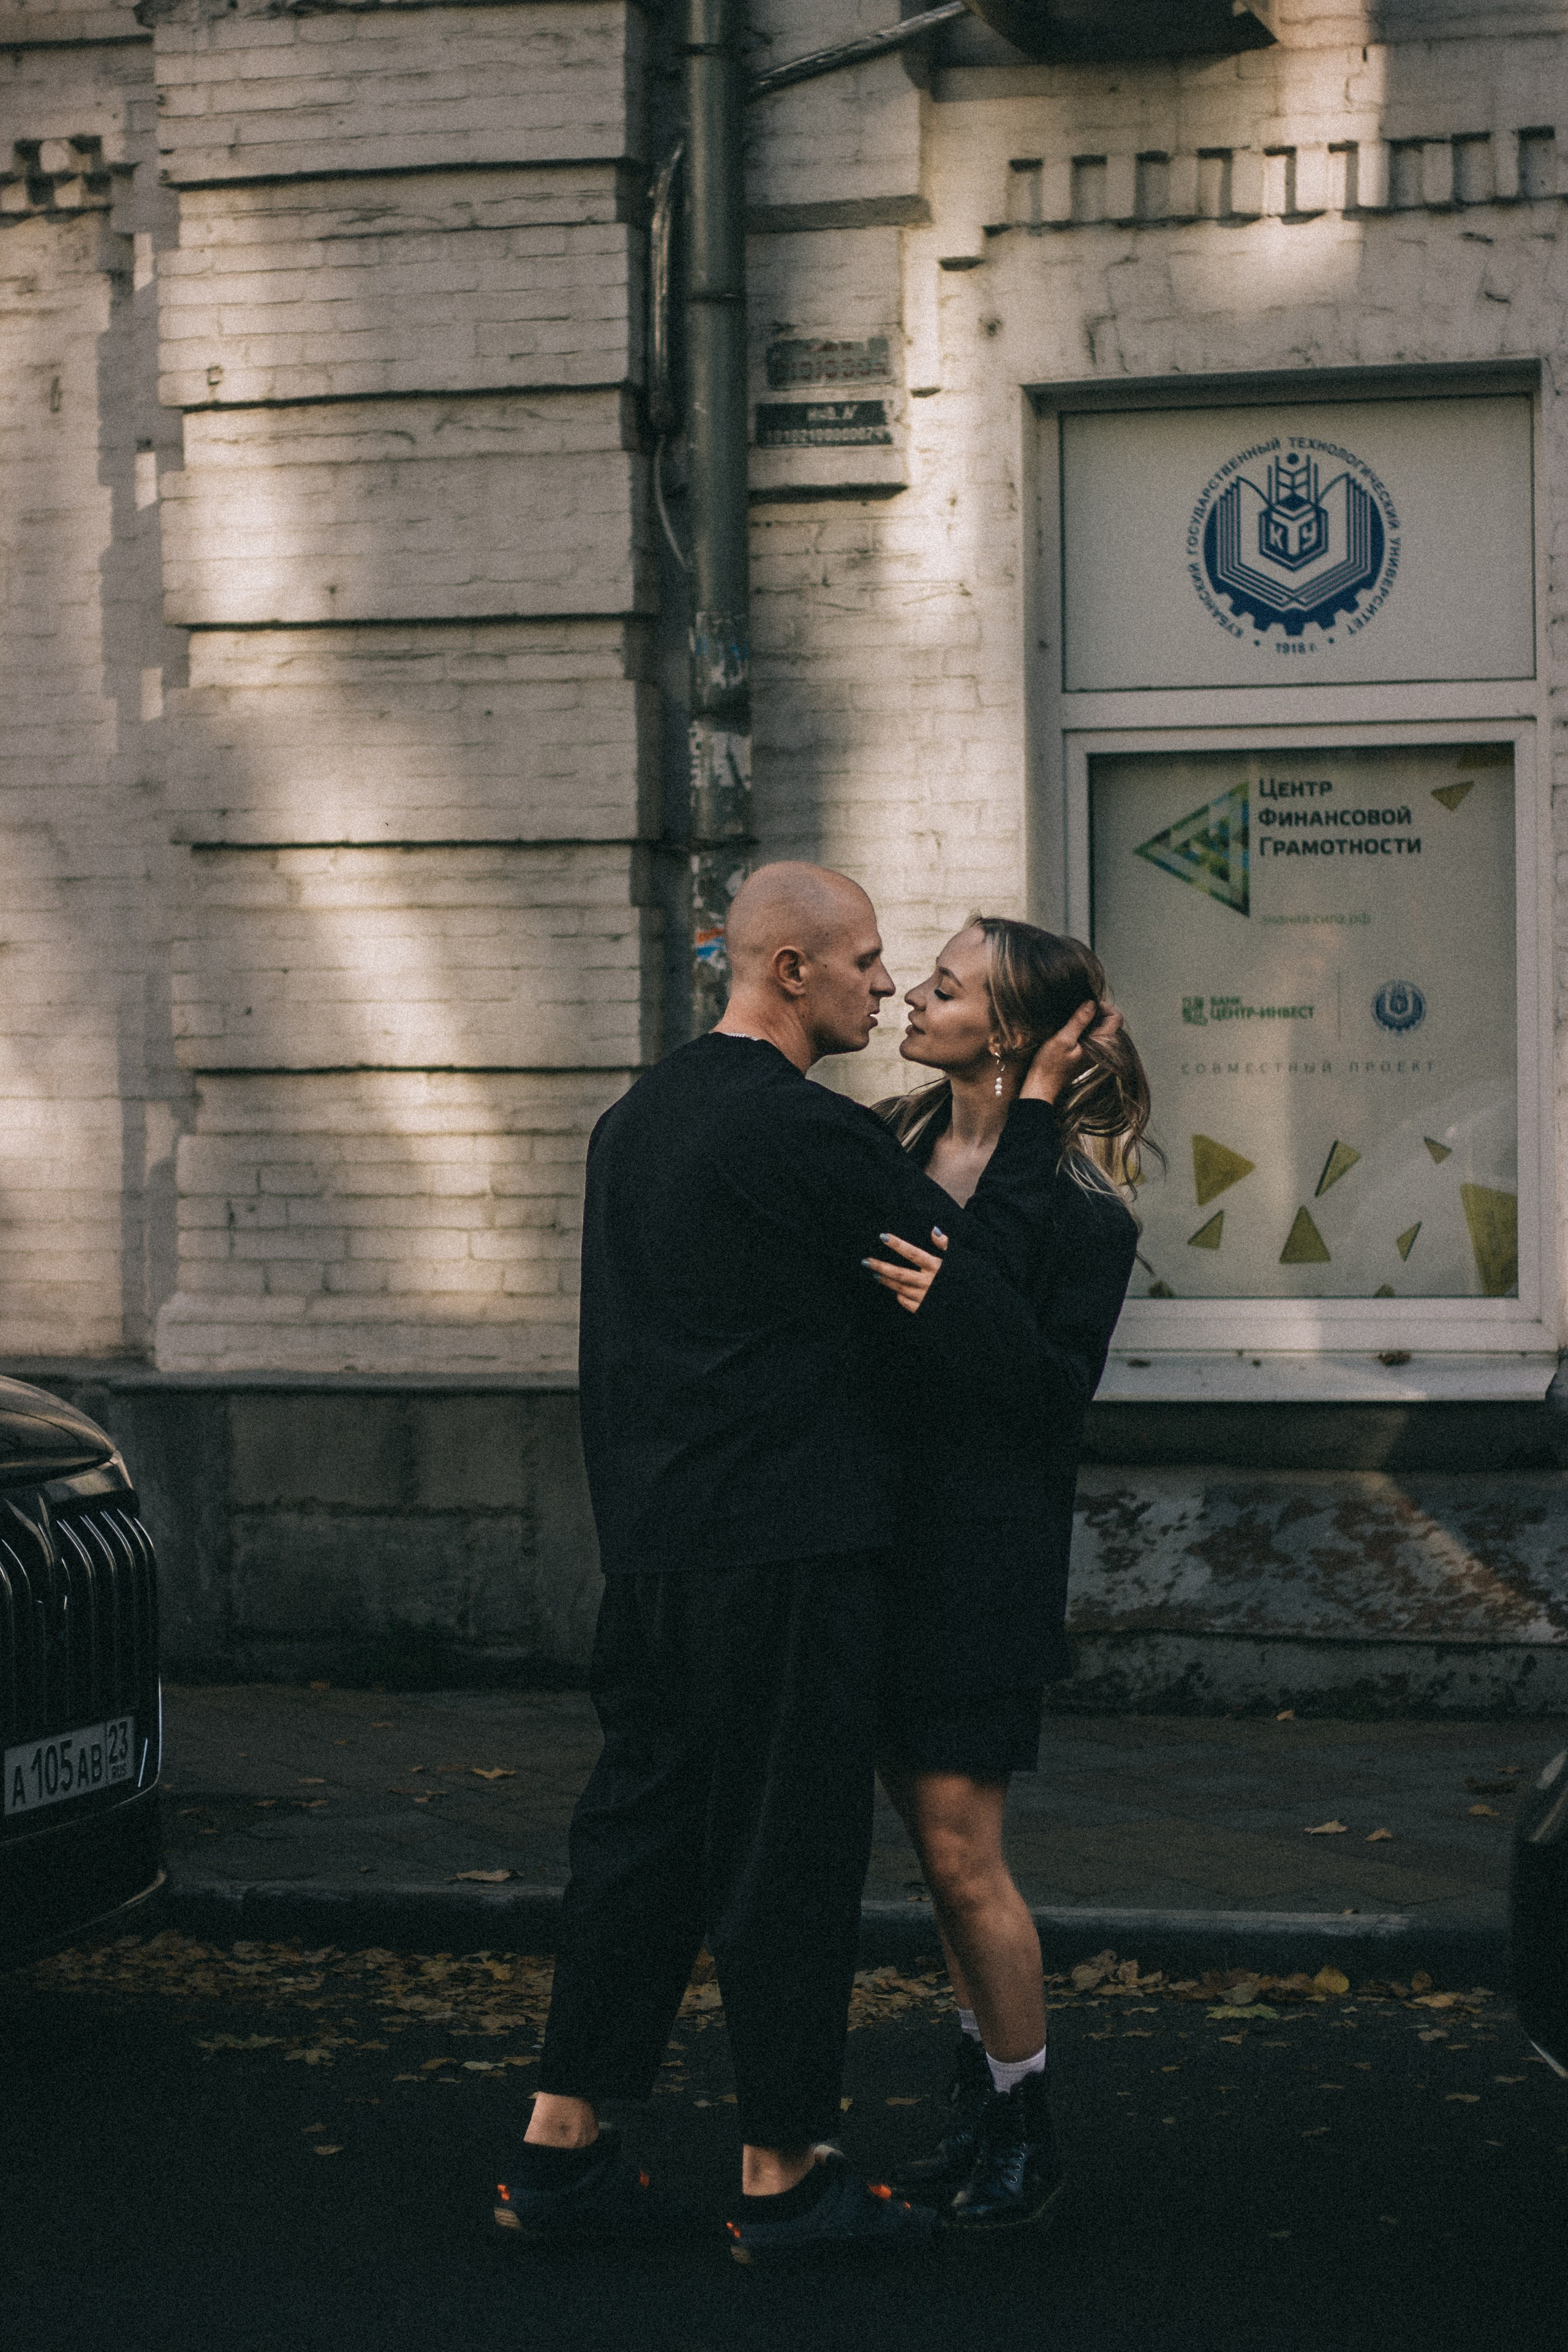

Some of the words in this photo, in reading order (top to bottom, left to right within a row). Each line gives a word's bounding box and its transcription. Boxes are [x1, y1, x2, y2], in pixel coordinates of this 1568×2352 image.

[1188, 437, 1281, 555] ГОСУДАРСТВЕННЫЙ
[1288, 437, 1400, 529] ТЕХНОЛОГИЧЕСКИЙ
[1188, 562, 1245, 639] КУБАНСКИЙ
[1346, 537, 1401, 635] УНИВЕРСИТЕТ
[1210, 1006, 1315, 1020] ЦЕНТР-ИНВЕСТ
[1182, 1060, 1332, 1075] СОВМЕСТНЫЙ
[1349, 1060, 1434, 1074] ПРОЕКТ
[108, 1721, 127, 1763] 23
